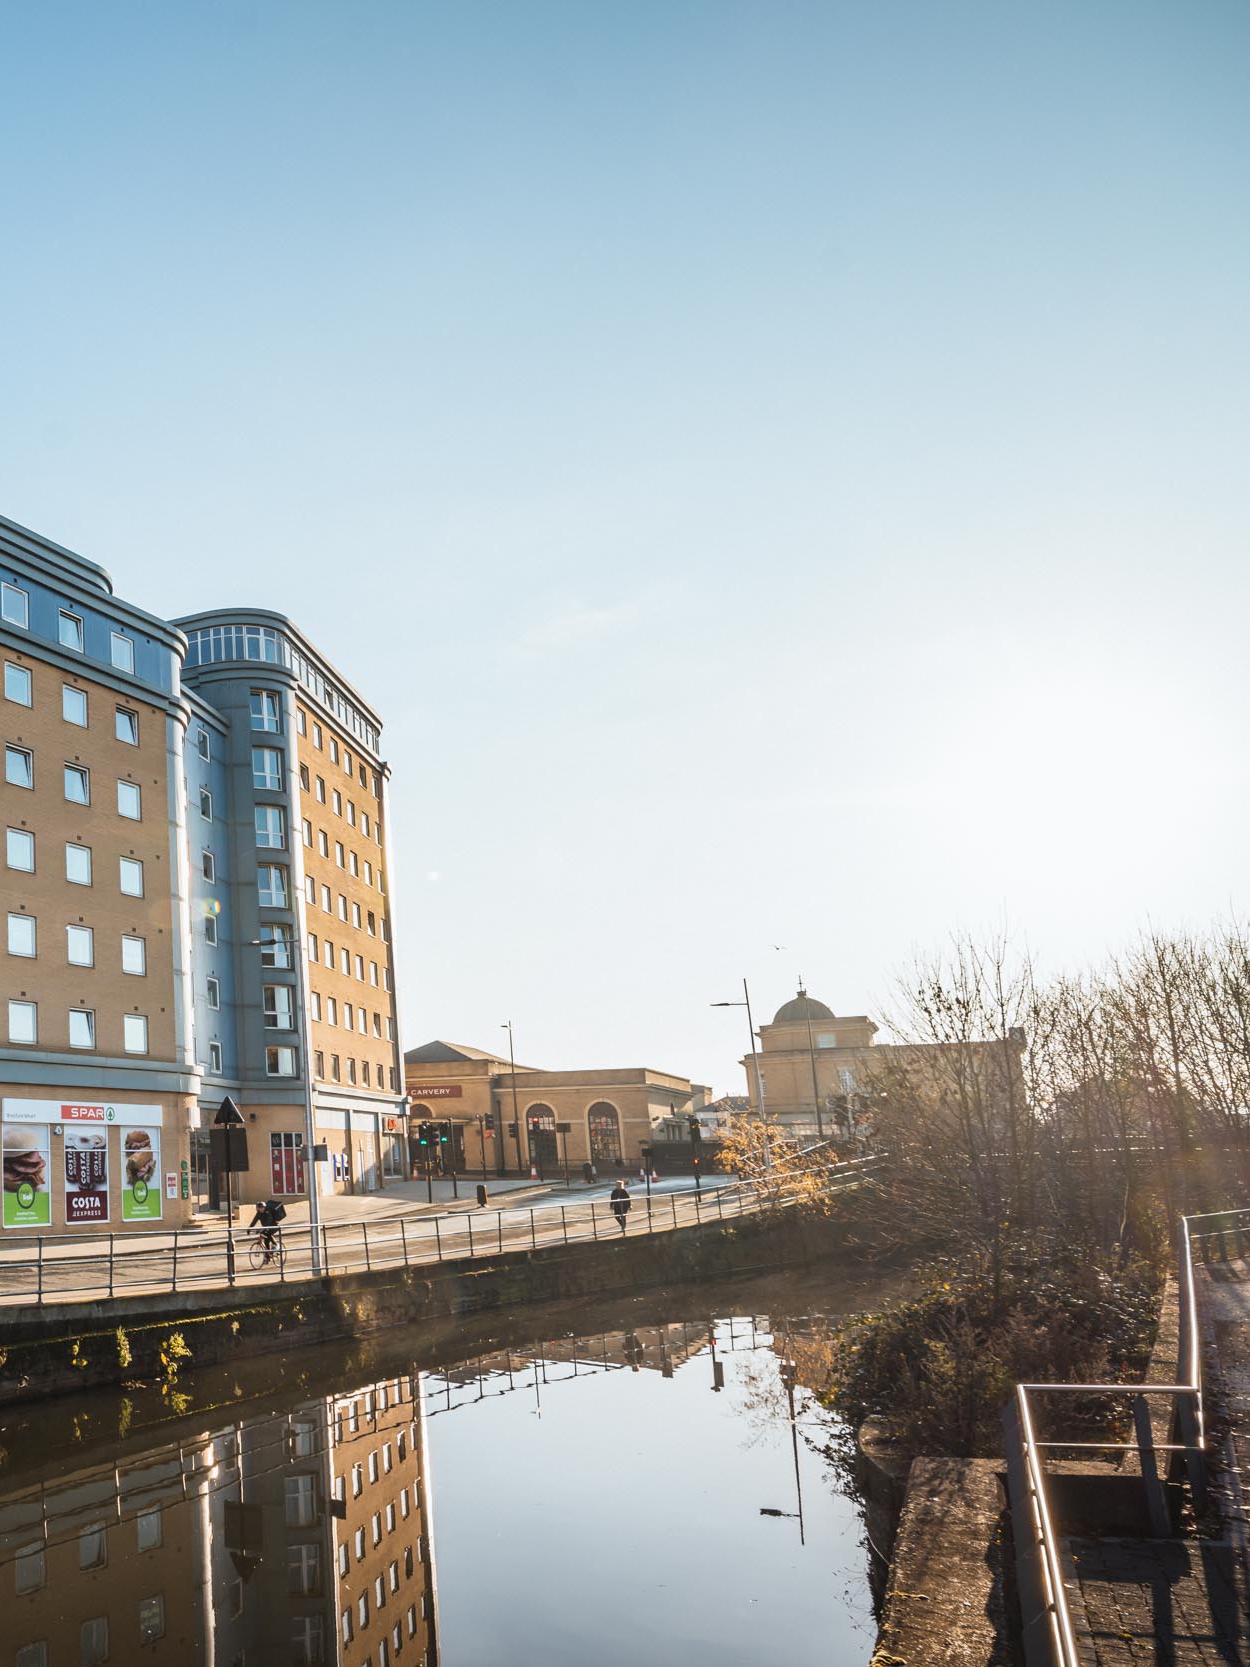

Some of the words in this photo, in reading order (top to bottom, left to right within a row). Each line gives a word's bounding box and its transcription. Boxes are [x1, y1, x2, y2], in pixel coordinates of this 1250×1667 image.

[411, 1088, 451, 1096] CARVERY
[71, 1107, 104, 1119] SPAR
[72, 1197, 101, 1209] COSTA
